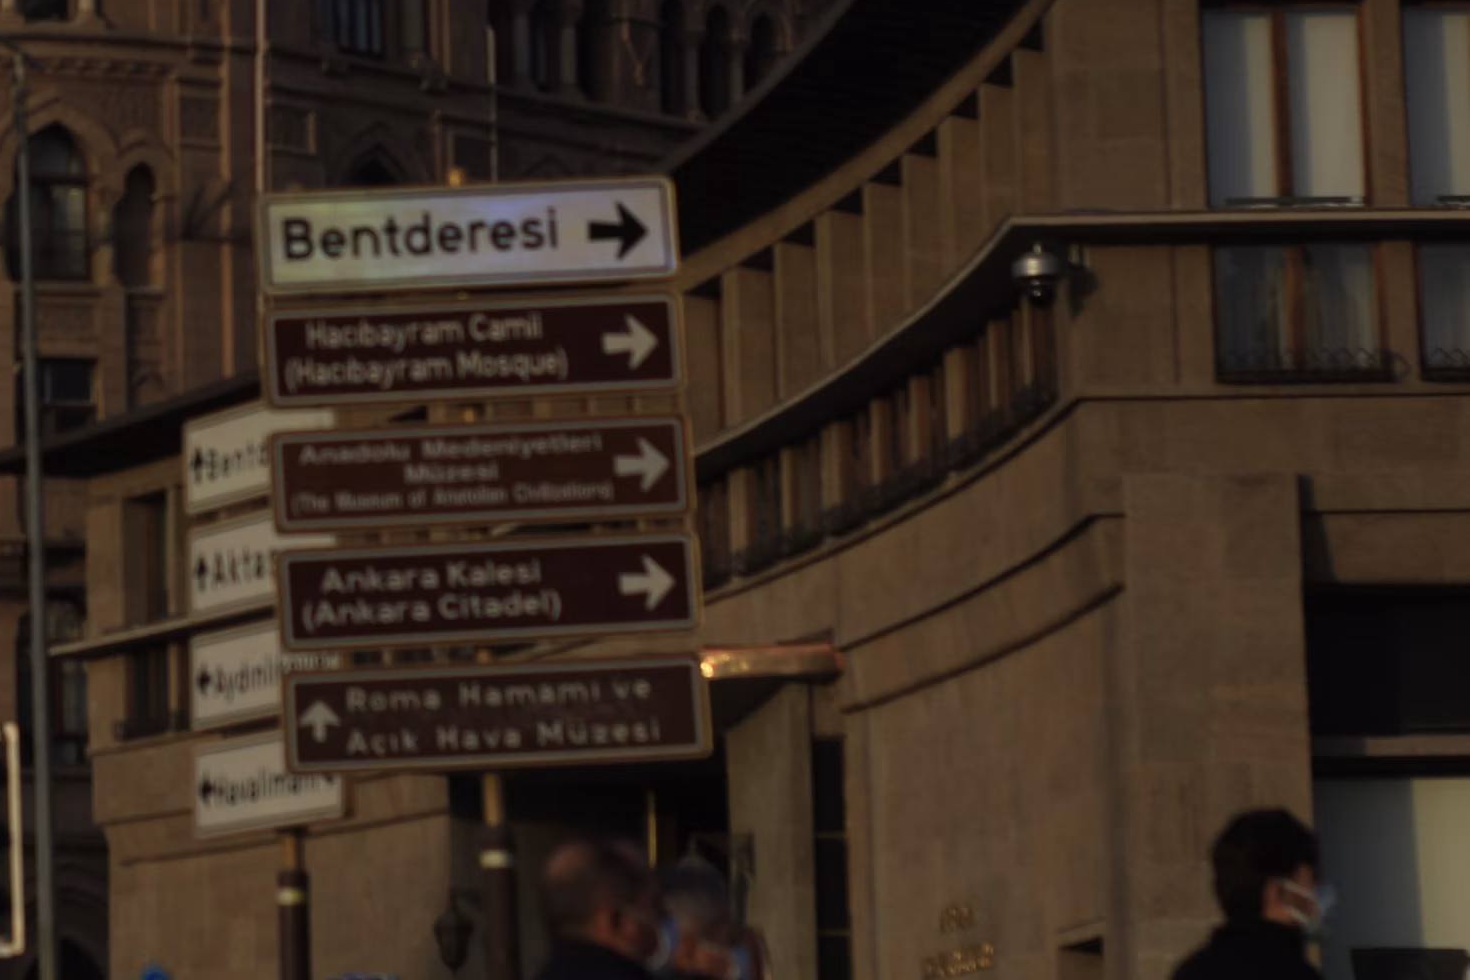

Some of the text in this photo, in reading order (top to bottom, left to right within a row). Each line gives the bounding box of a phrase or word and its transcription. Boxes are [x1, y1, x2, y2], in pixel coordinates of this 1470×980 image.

[283, 208, 559, 260] Bentderesi
[319, 556, 543, 595] Ankara Kalesi
[302, 587, 563, 633] (Ankara Citadel)
[345, 684, 442, 714] Roma
[612, 676, 653, 701] ve
[436, 725, 523, 752] Hava
[536, 719, 662, 749] Müzesi
